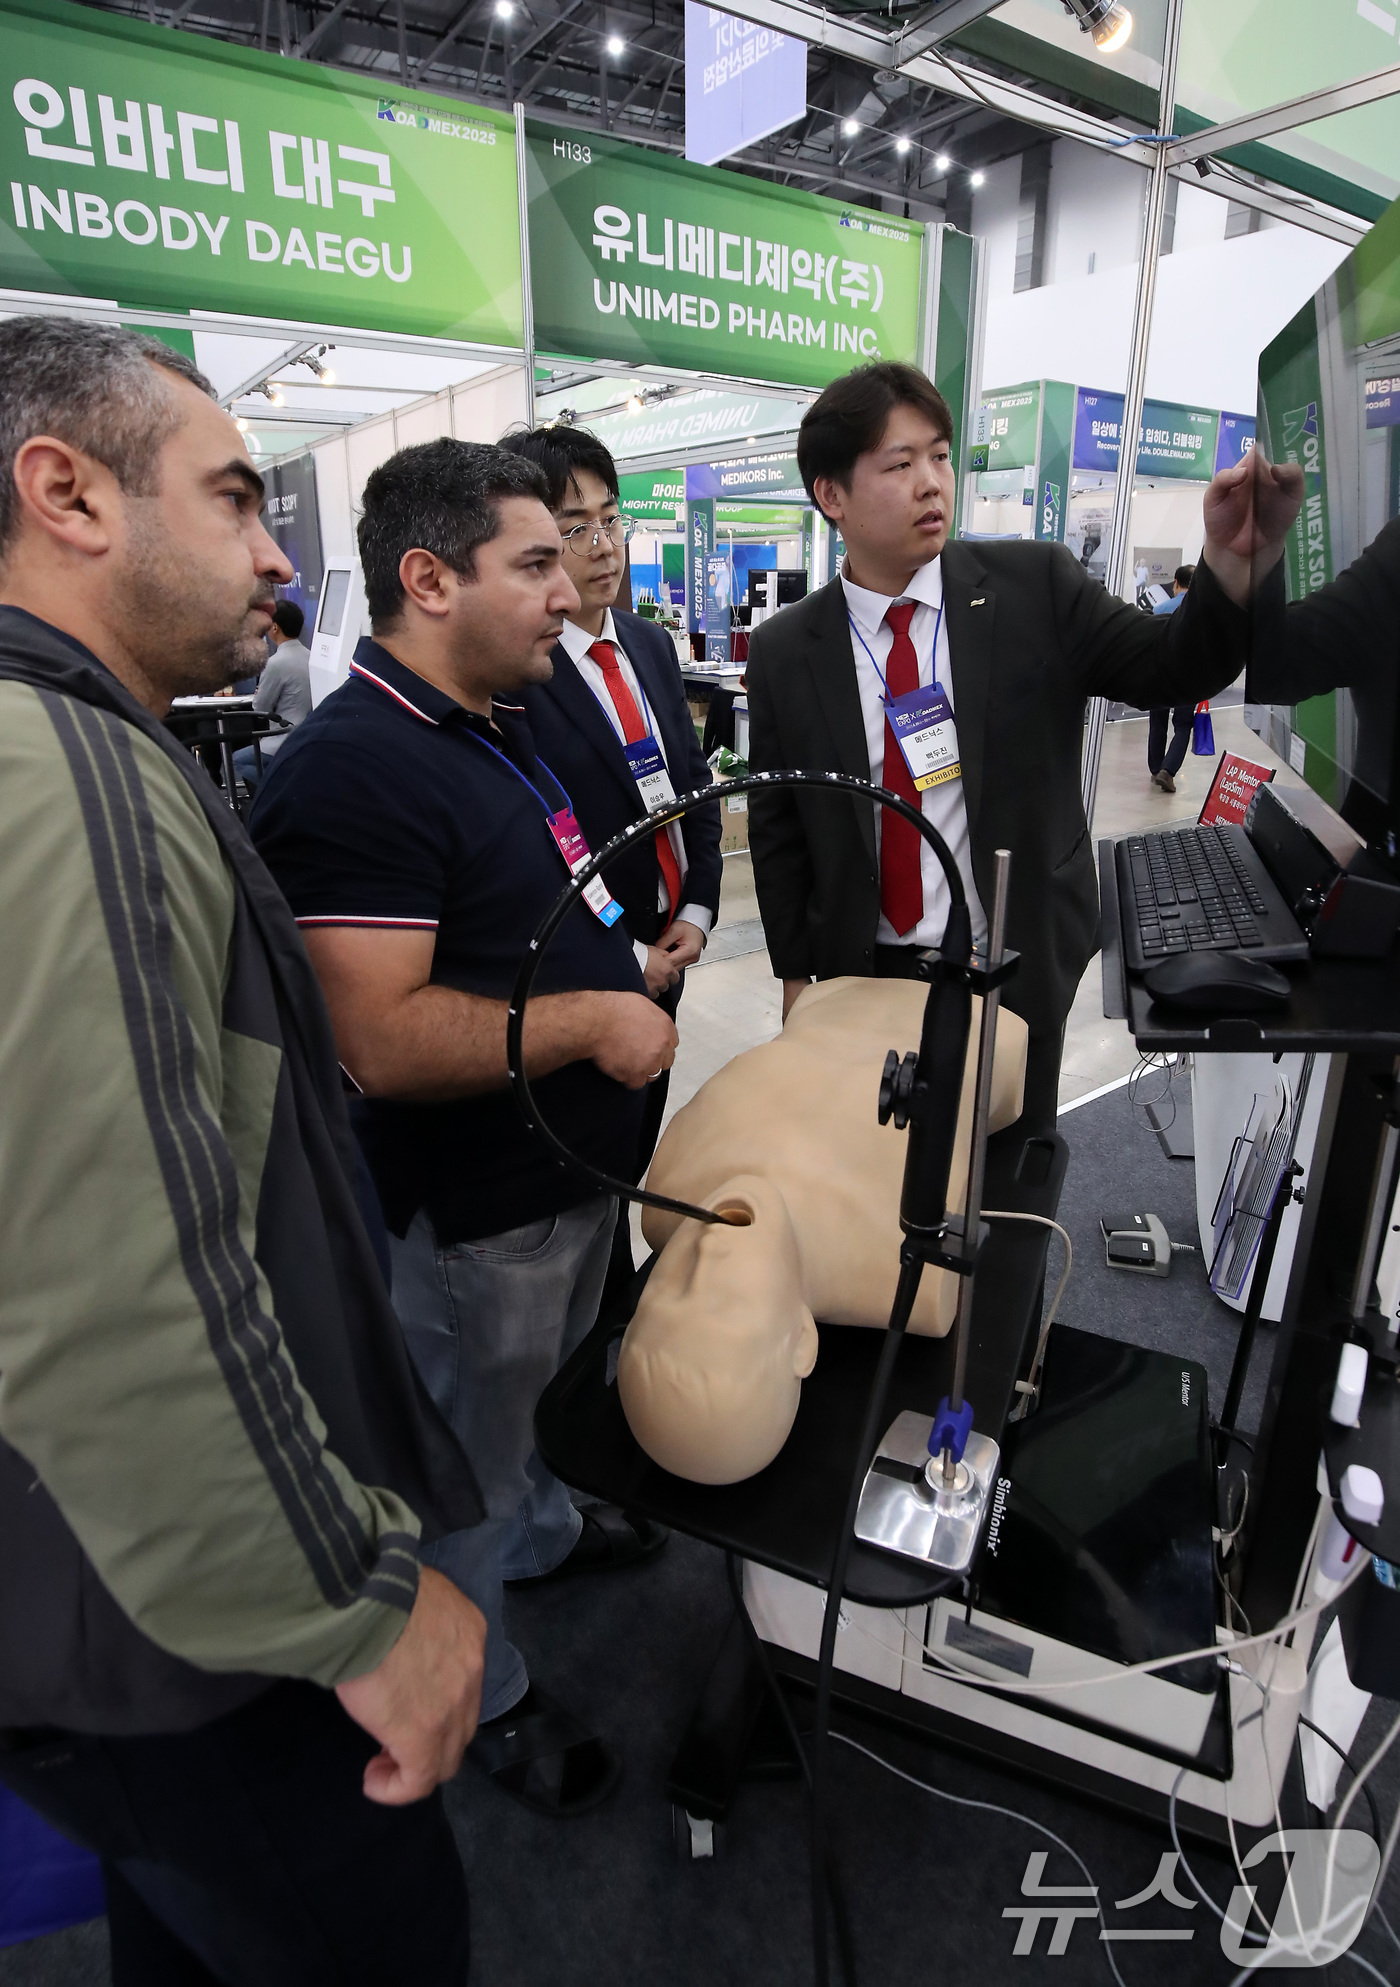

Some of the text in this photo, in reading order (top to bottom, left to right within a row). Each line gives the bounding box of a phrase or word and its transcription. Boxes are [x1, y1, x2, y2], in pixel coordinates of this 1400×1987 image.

[12, 78, 396, 218] 인바디 대구
[552, 138, 591, 164] H133
[10, 181, 412, 283] INBODY DAEGU
[592, 204, 884, 313] 유니메디제약(주)
[593, 278, 720, 330] UNIMED
[728, 303, 827, 345] PHARM
[977, 416, 986, 442] H133
[1092, 420, 1118, 438] 일상에
[1152, 447, 1195, 460] DOUBLEWALKING
[721, 468, 784, 486] MEDIKORS Inc.
[622, 500, 661, 510] MIGHTY
[1220, 777, 1244, 798] (LapSim)
[1225, 764, 1260, 788] LAP Mentor
[1181, 1384, 1190, 1406] Mentor
[986, 1477, 1012, 1551] Simbionix
